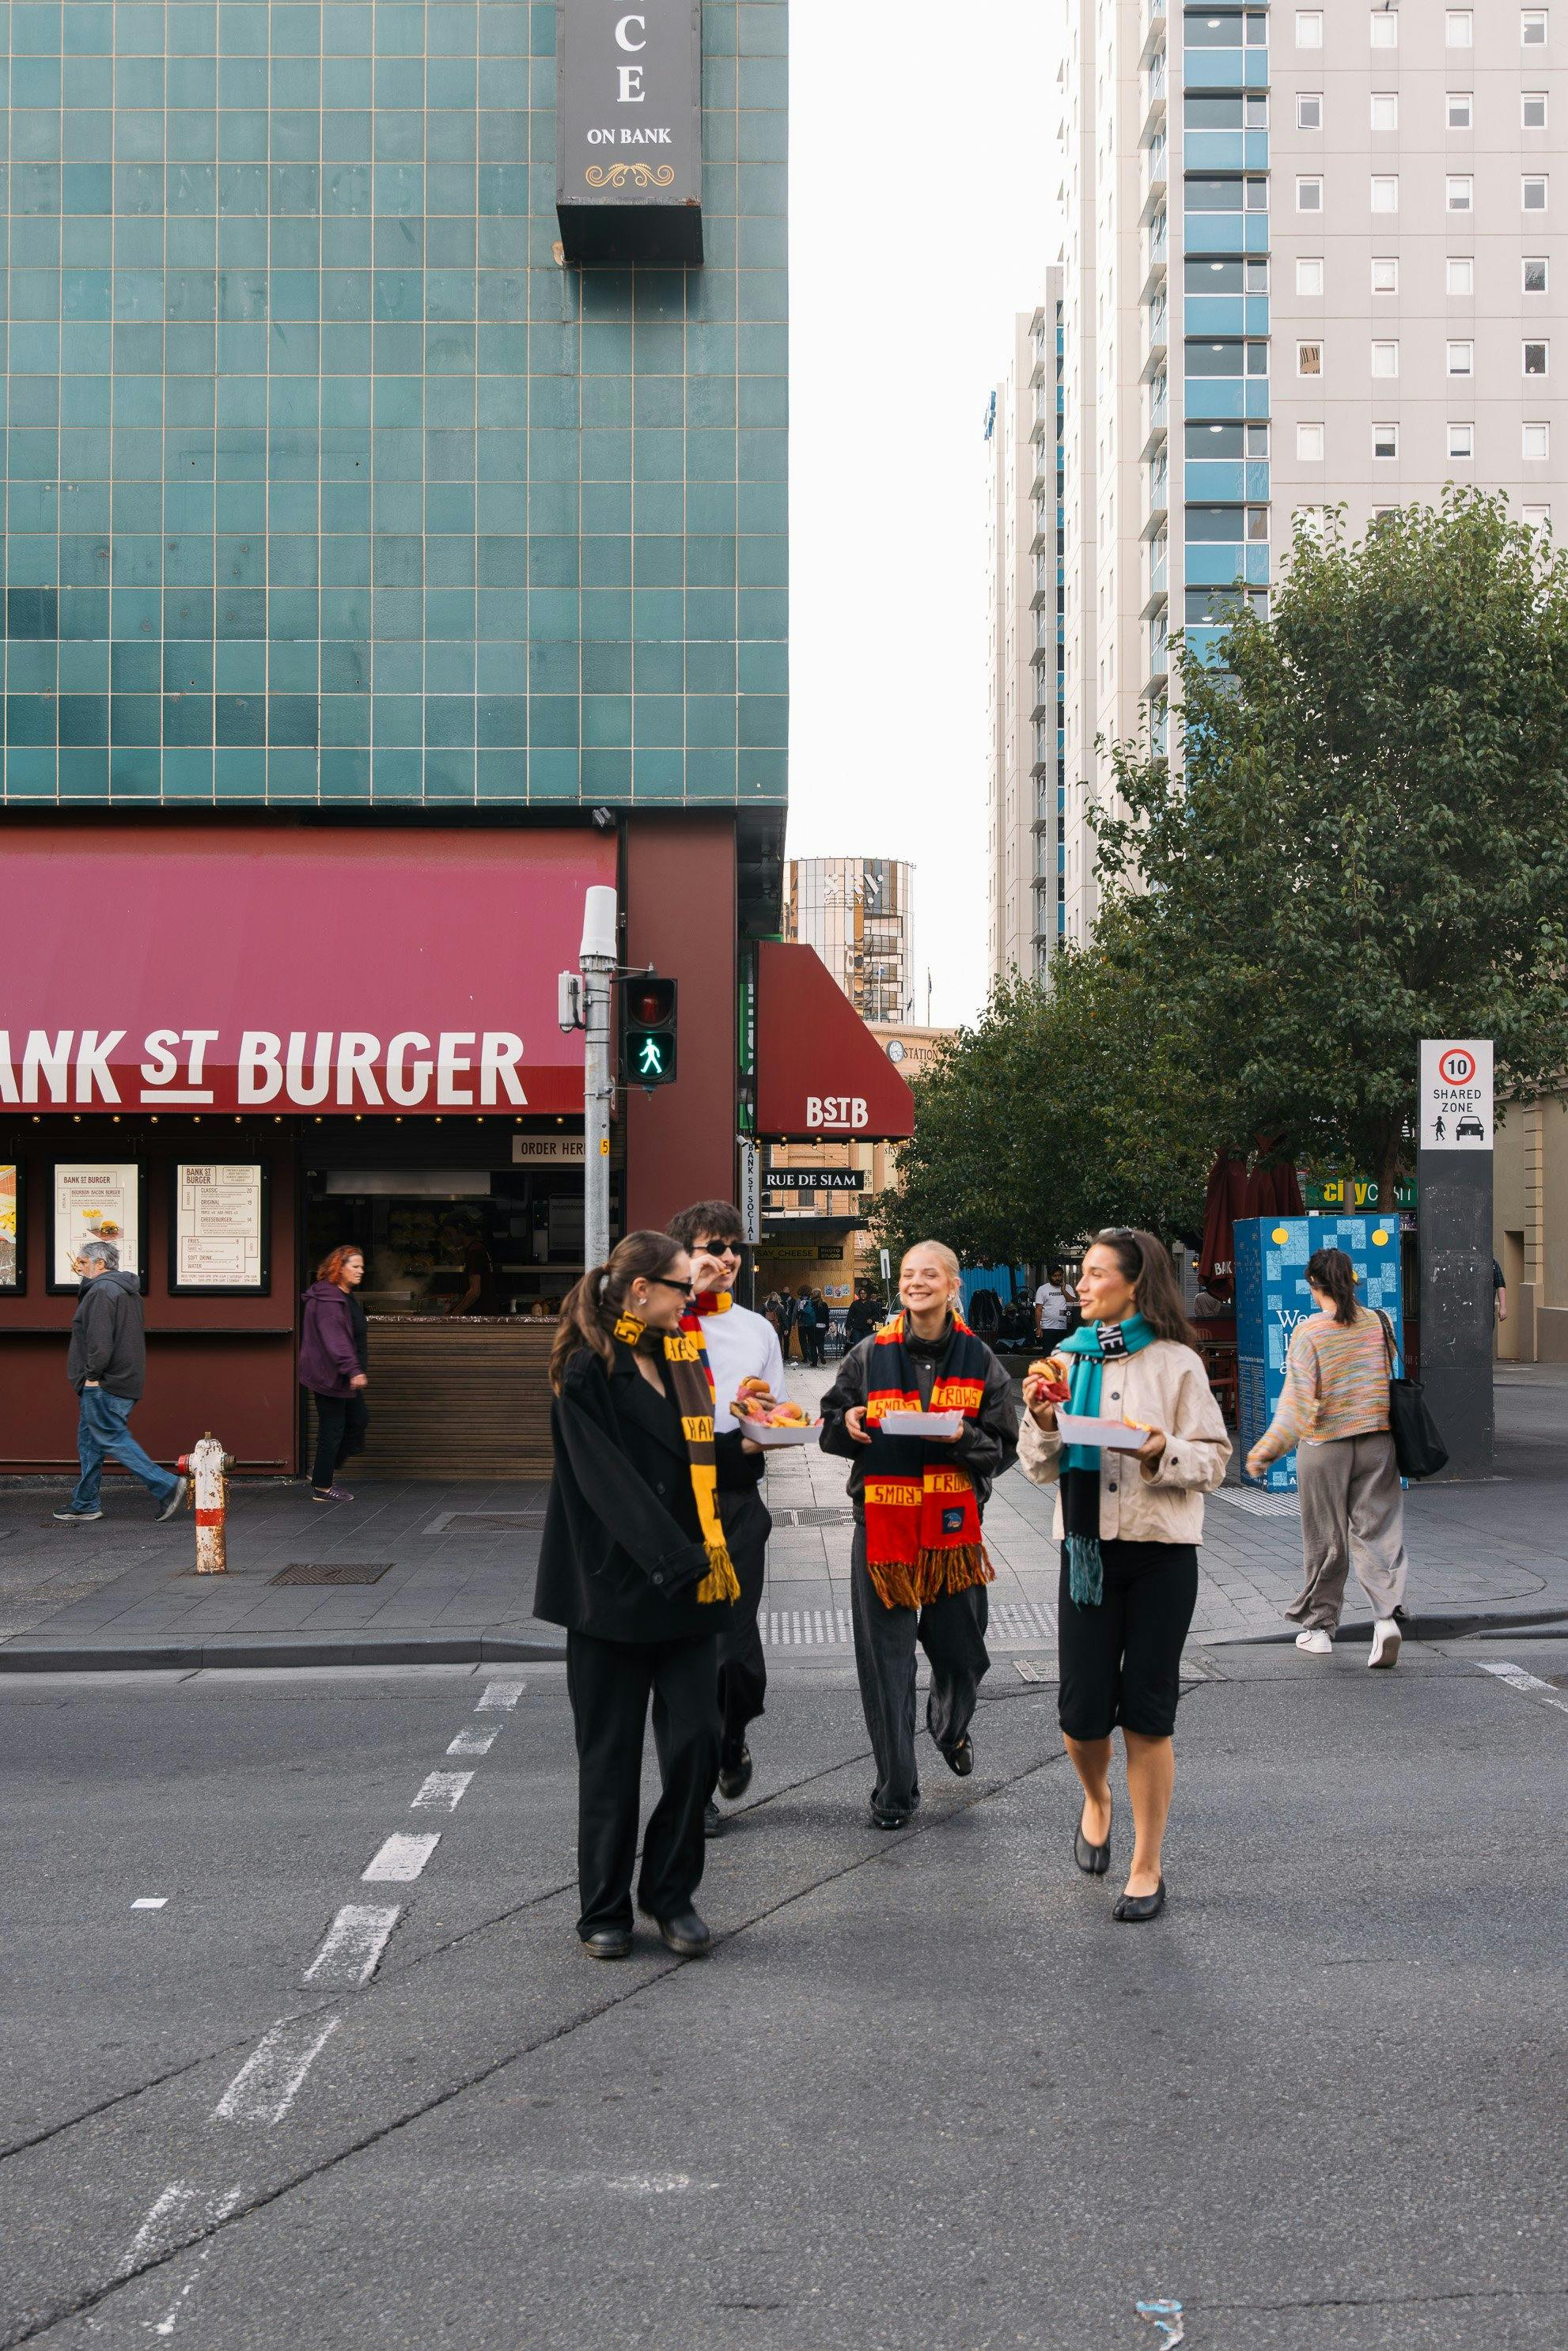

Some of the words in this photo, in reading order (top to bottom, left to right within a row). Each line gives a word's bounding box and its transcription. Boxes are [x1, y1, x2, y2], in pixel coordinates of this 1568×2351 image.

[587, 128, 615, 144] ON
[620, 128, 672, 144] BANK
[903, 1047, 938, 1060] STATION
[140, 1029, 219, 1104] ST
[237, 1031, 528, 1107] BURGER
[1448, 1059, 1468, 1075] 10
[1433, 1089, 1482, 1099] SHARED
[807, 1096, 869, 1128] BSTB
[1441, 1103, 1473, 1112] ZONE
[521, 1142, 556, 1155] ORDER
[562, 1142, 585, 1155] HER
[603, 1141, 608, 1153] 5
[767, 1174, 795, 1186] RUE
[798, 1174, 816, 1186] DE
[820, 1174, 856, 1186] SIAM
[937, 1388, 979, 1407] CROWS
[934, 1474, 972, 1492] CROWS
